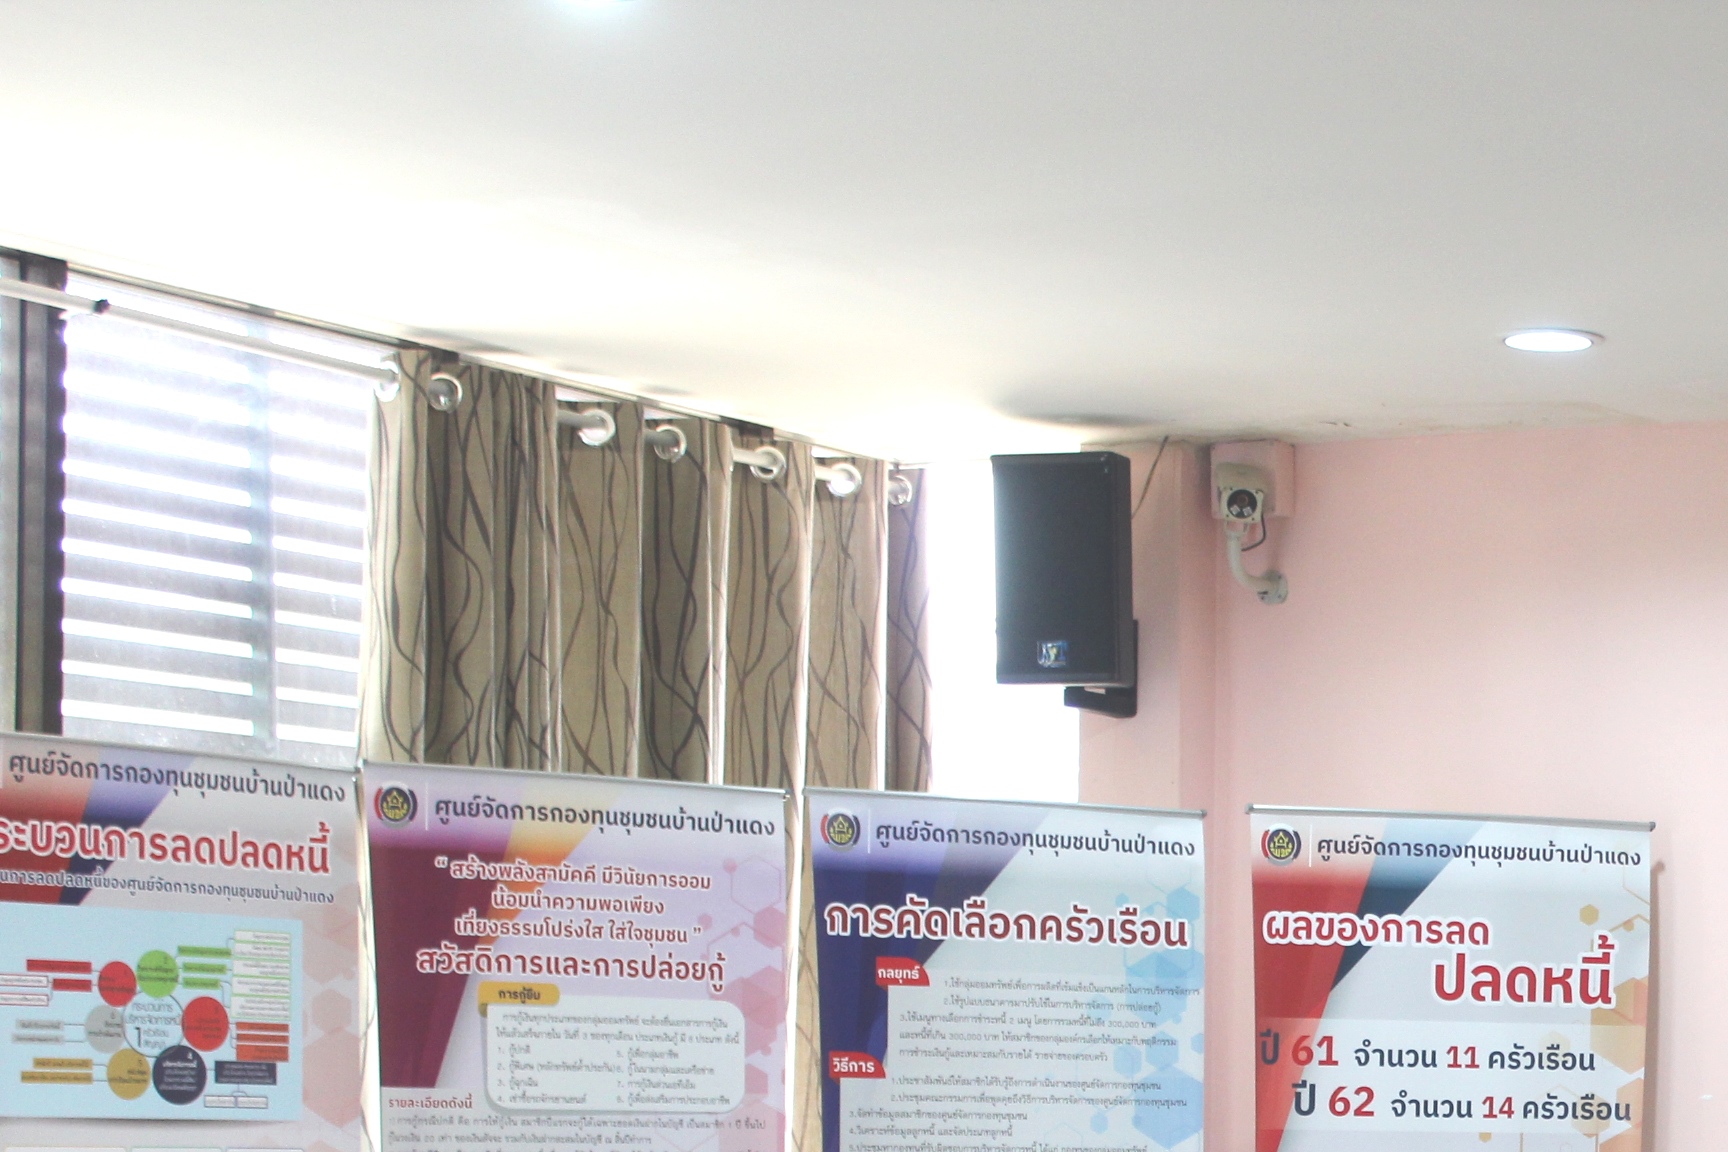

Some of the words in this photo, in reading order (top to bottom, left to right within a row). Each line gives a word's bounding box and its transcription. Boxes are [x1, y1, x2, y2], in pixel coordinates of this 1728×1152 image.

[9, 751, 345, 801] ศูนย์จัดการกองทุนชุมชนบ้านป่าแดง
[434, 795, 776, 837] ศูนย์จัดการกองทุนชุมชนบ้านป่าแดง
[0, 820, 330, 874] ระบวนการลดปลดหนี้
[875, 820, 1196, 857] ศูนย์จัดการกองทุนชุมชนบ้านป่าแดง
[1317, 834, 1641, 869] ศูนย์จัดการกองทุนชุมชนบ้านป่าแดง
[450, 855, 597, 884] สร้างพลังสามัคคี
[602, 868, 711, 890] มีวินัยการออม
[491, 887, 665, 914] น้อมนำความพอเพียง
[455, 909, 604, 940] เที่ยงธรรมโปร่งใส
[609, 920, 689, 948] ใส่ใจชุมชน
[826, 895, 1188, 949] การคัดเลือกครัวเรือน
[1267, 915, 1490, 946] ผลของการลด
[417, 946, 727, 992] สวัสดิการและการปล่อยกู้
[877, 964, 921, 984] กลยุทธ์
[1435, 934, 1615, 1005] ปลดหนี้
[498, 985, 542, 1004] การกู้ยืม
[833, 1056, 875, 1073] วิธีการ
[1260, 1029, 1280, 1066] ปี
[1291, 1035, 1339, 1067] 61
[1354, 1040, 1437, 1069] จำนวน
[1446, 1046, 1480, 1069] 11
[1487, 1043, 1596, 1072] ครัวเรือน
[388, 1096, 474, 1110] รายละเอียดดังนี้
[1292, 1079, 1316, 1117] ปี
[1328, 1086, 1376, 1118] 62
[1391, 1091, 1473, 1119] จำนวน
[1482, 1096, 1515, 1119] 14
[1522, 1093, 1632, 1122] ครัวเรือน
